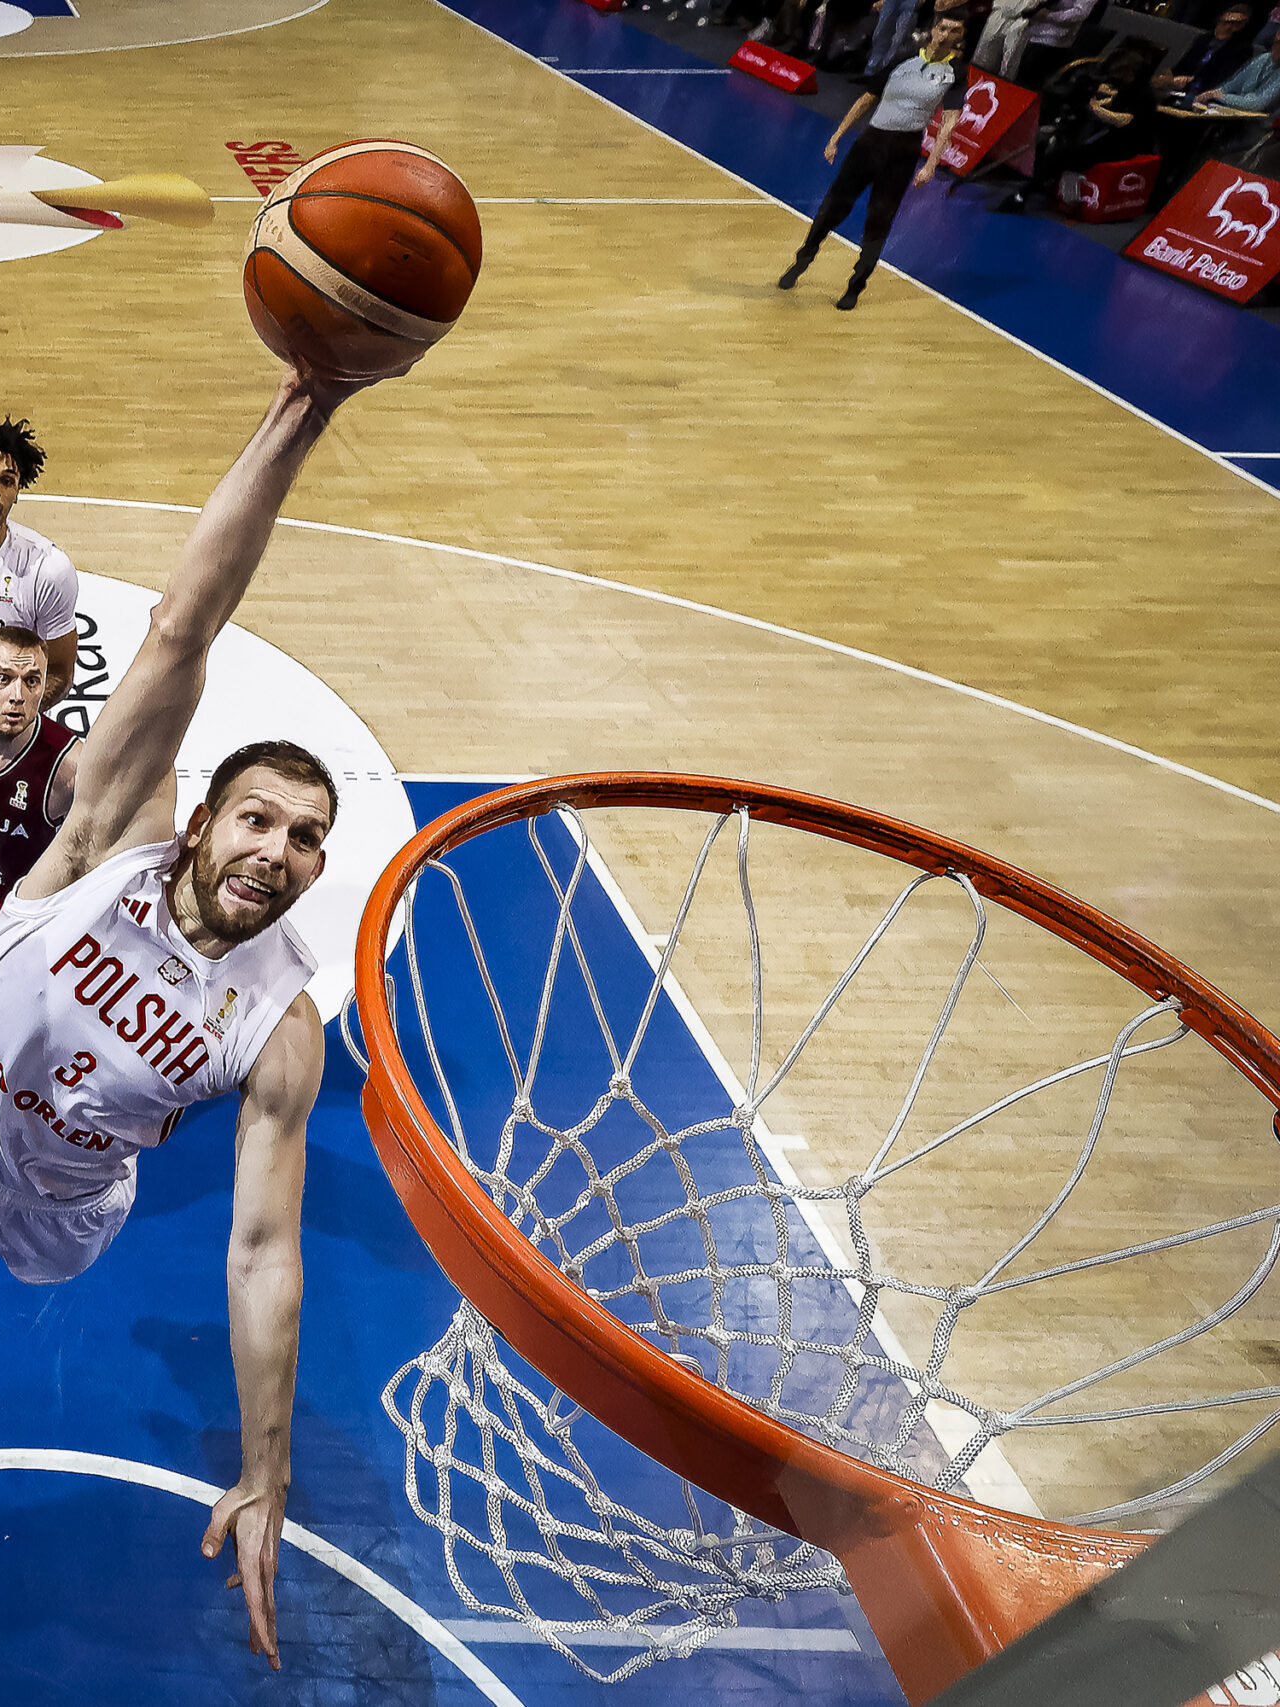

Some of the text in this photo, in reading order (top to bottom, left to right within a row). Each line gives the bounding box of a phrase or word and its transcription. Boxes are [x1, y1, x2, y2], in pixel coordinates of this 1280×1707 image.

[1143, 235, 1248, 290] Bank Pekao
[50, 933, 210, 1086] POLSKA
[54, 1051, 97, 1088] 3
[13, 1090, 115, 1152] ORLEN
